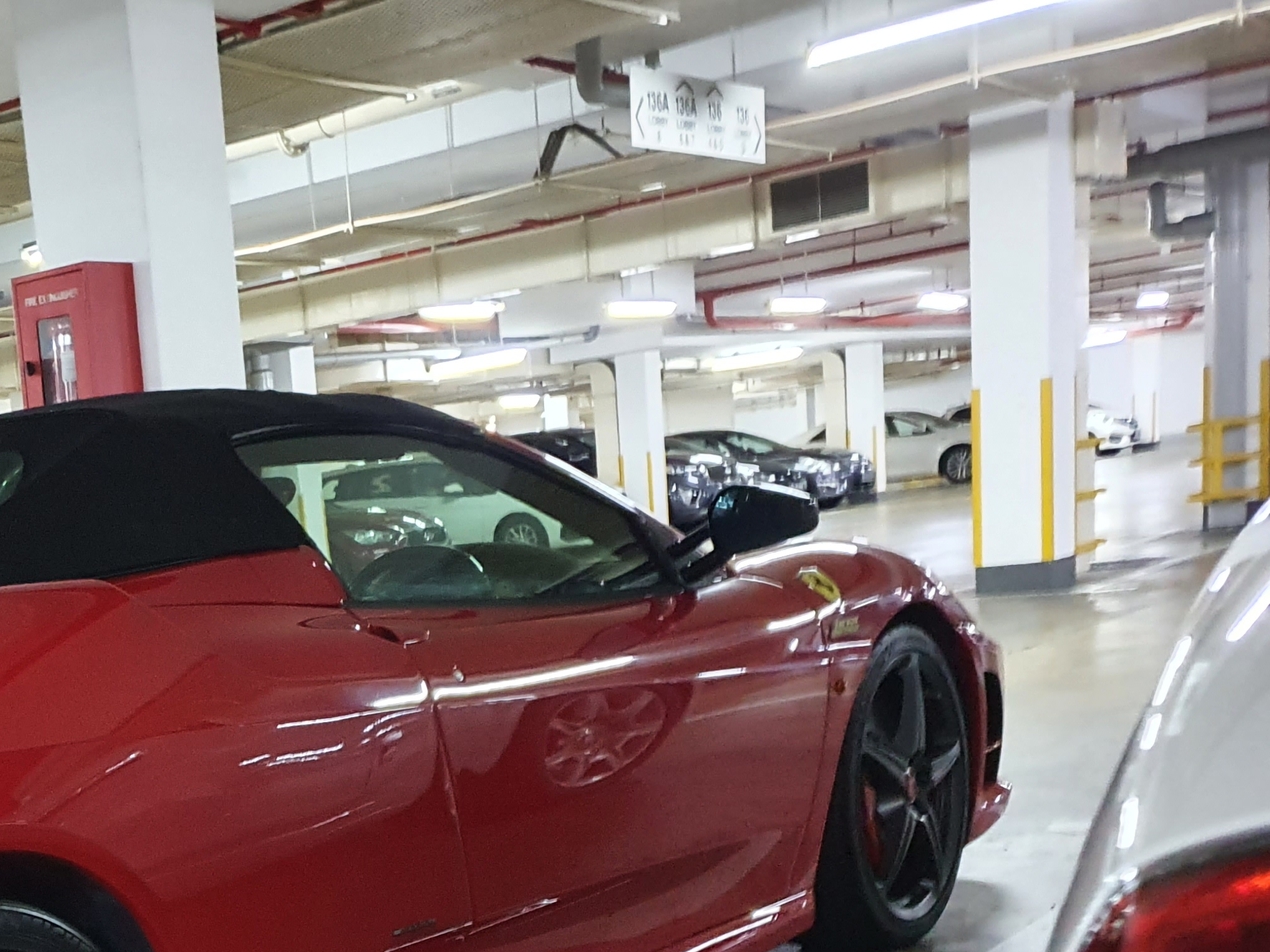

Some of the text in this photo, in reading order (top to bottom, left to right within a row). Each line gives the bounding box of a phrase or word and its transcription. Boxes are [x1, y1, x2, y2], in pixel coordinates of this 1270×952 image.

[647, 91, 670, 113] 136A
[675, 96, 698, 118] 136A
[707, 100, 723, 122] 136
